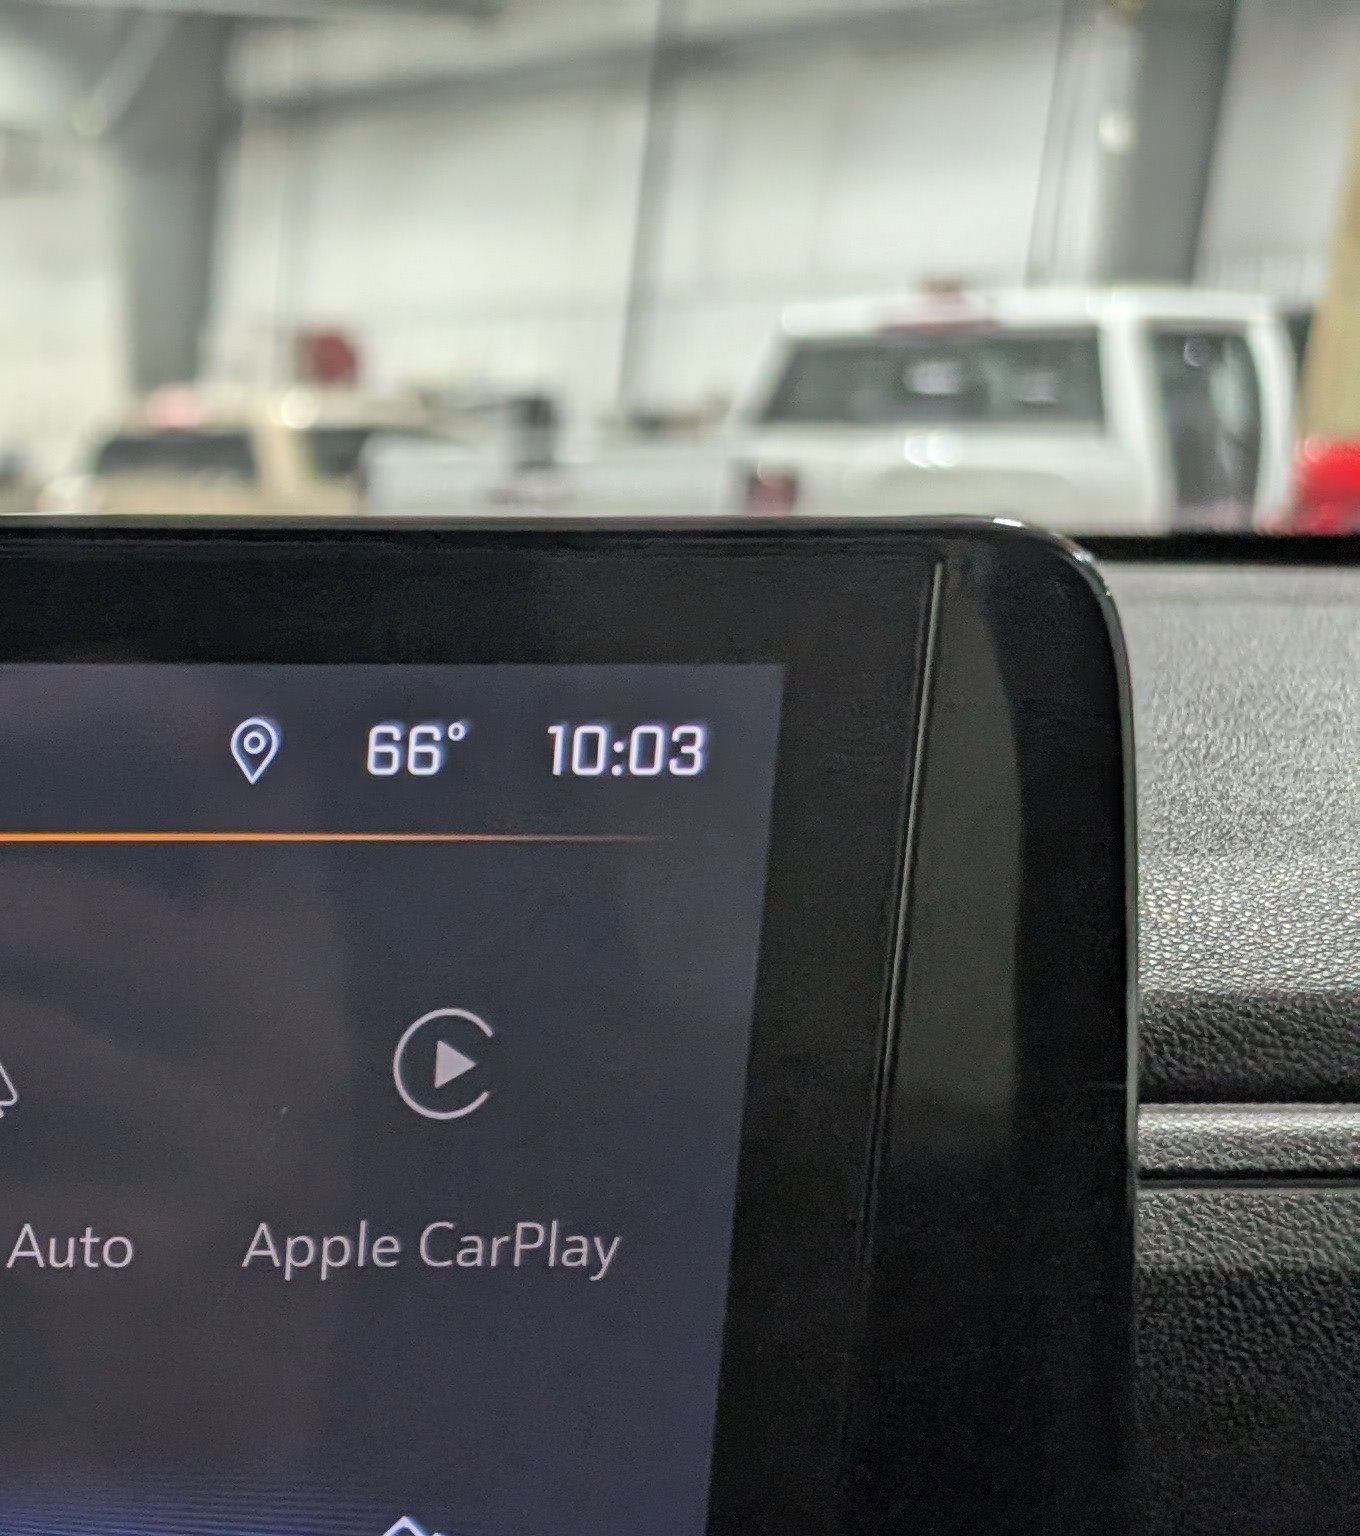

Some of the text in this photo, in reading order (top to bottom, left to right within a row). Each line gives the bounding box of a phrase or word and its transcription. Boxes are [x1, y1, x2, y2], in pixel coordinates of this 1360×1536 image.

[546, 722, 708, 778] 10:03
[6, 1223, 135, 1270] Auto
[241, 1219, 622, 1283] Apple CarPlay
